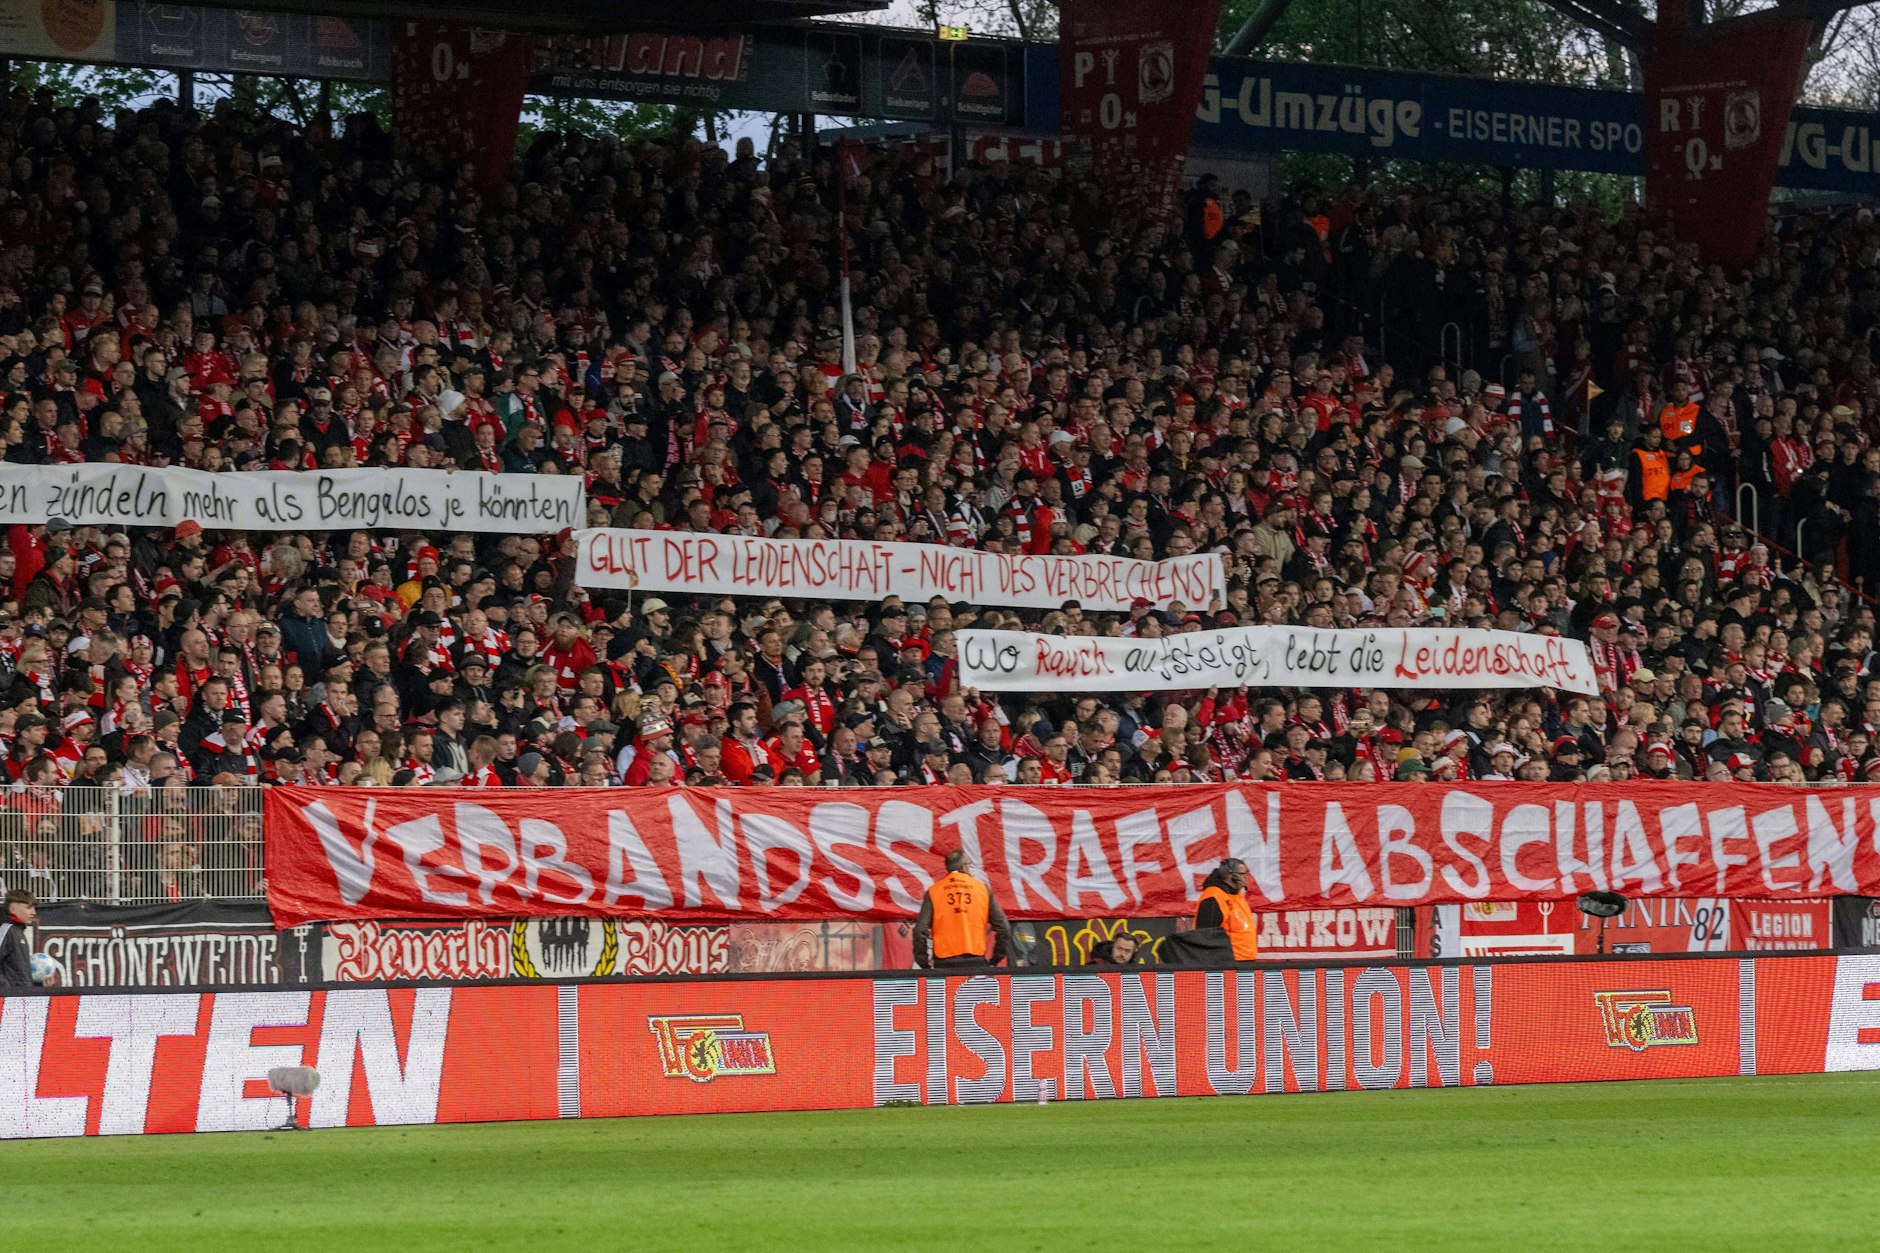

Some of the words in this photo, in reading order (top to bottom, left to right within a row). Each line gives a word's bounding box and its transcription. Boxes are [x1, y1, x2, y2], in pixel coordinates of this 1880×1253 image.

[552, 75, 571, 88] mit
[574, 77, 596, 90] uns
[600, 77, 660, 95] entsorgen
[664, 80, 681, 95] sie
[684, 82, 720, 101] richtig
[1449, 107, 1582, 149] EISERNER
[46, 471, 167, 519] zündeln
[183, 481, 236, 522] mehr
[256, 479, 302, 522] als
[318, 477, 431, 528] Bengalos
[440, 484, 465, 527] je
[590, 533, 651, 577] GLUT
[664, 538, 720, 588] DER
[732, 539, 893, 593] LEIDENSCHAFT
[920, 551, 985, 596] NICHT
[1000, 553, 1036, 596] DES
[1045, 555, 1216, 602] VERBRECHENS!
[964, 637, 1021, 675] Wo
[1035, 637, 1114, 679] Rauch
[1125, 632, 1270, 682] aufsteigt,
[1285, 633, 1342, 672] lebt
[1350, 632, 1384, 672] die
[300, 789, 1285, 912] VERBANDSSTRAFEN
[947, 892, 972, 905] 373
[330, 918, 510, 981] Beverly
[622, 918, 730, 976] Boys
[1252, 908, 1395, 947] ANKOW
[1694, 907, 1725, 942] 82
[1750, 911, 1813, 938] LEGION
[42, 927, 279, 986] SCHÖNEWEIDE
[874, 972, 1176, 1107] EISERN
[1203, 965, 1493, 1095] UNION!
